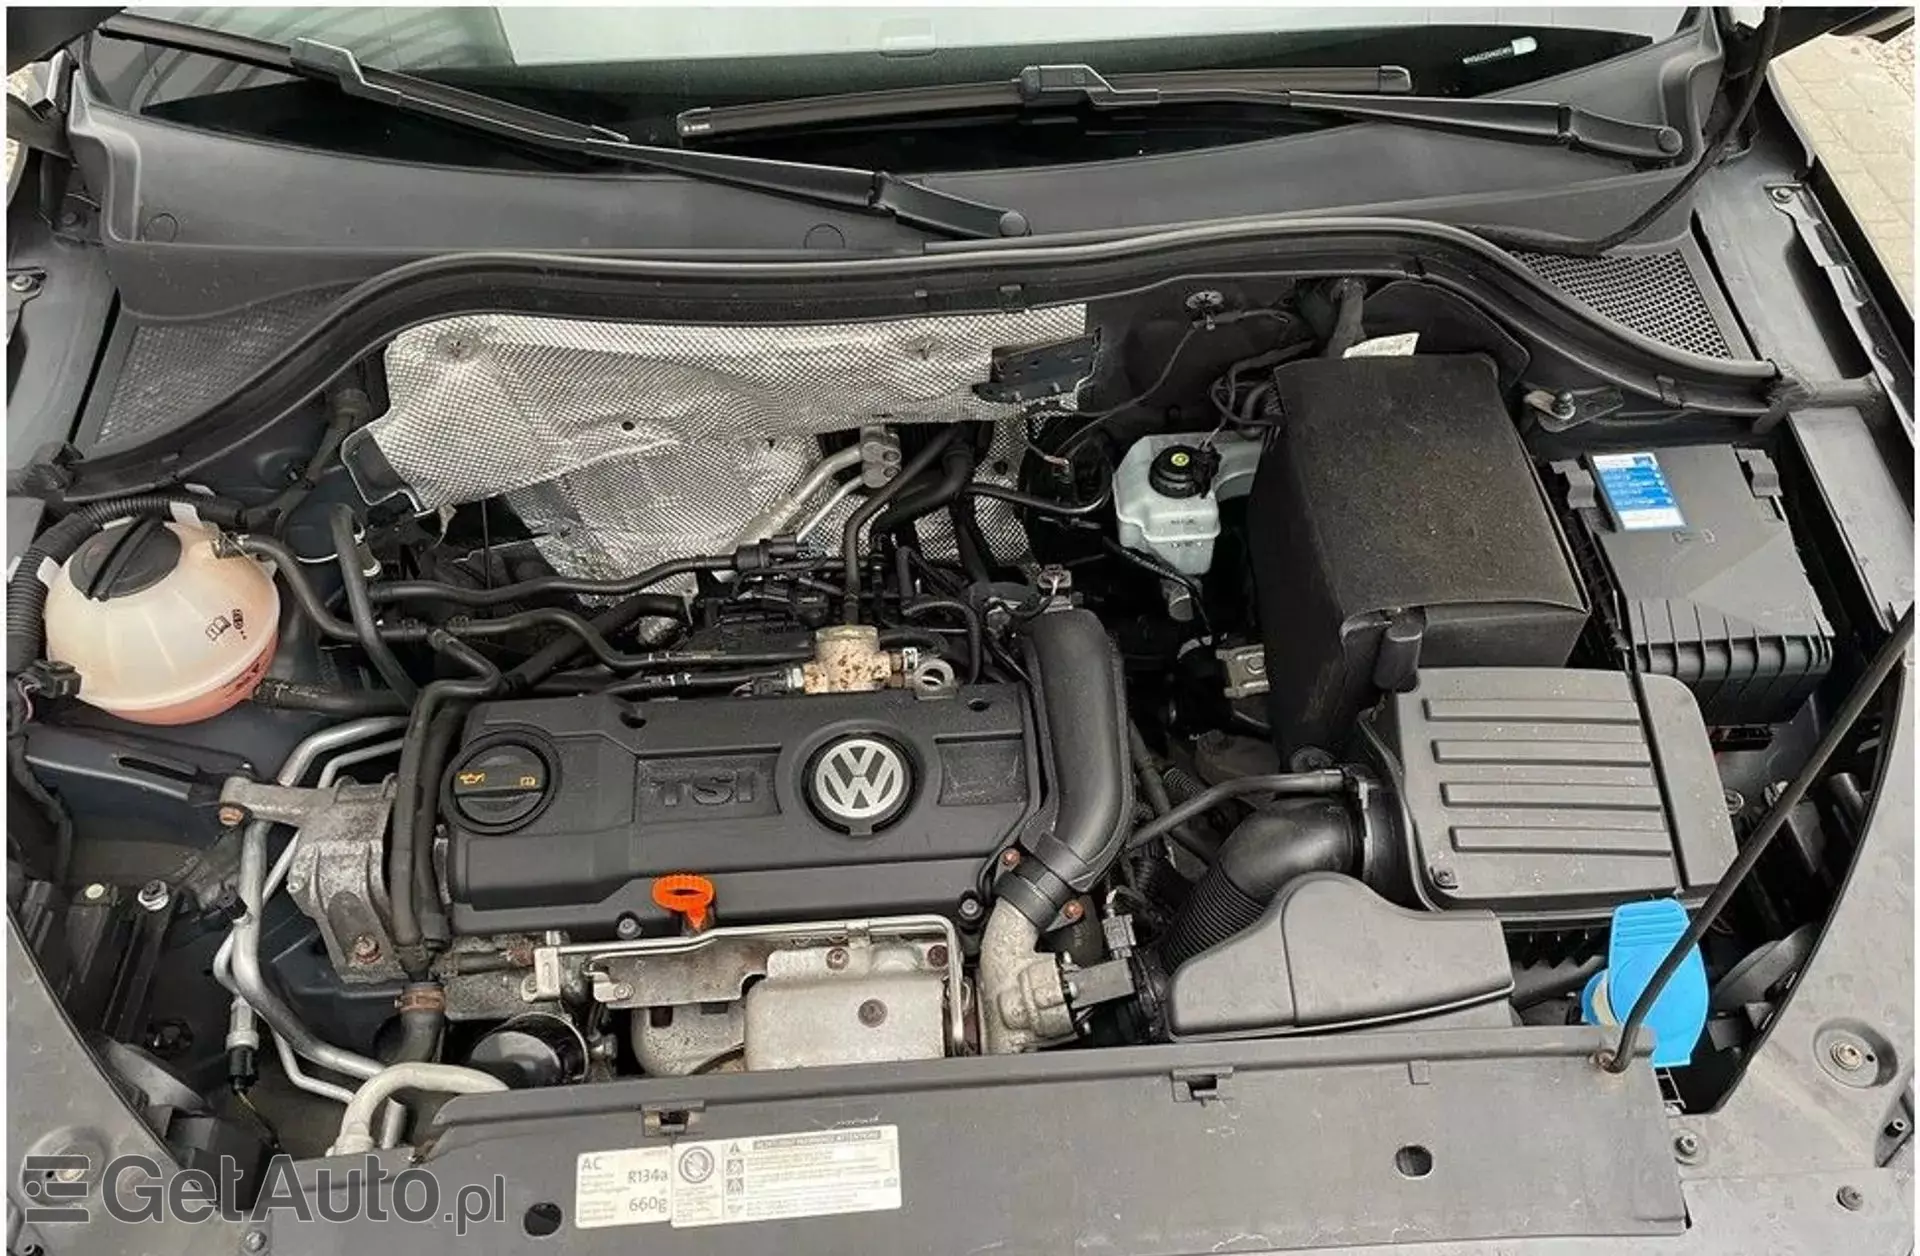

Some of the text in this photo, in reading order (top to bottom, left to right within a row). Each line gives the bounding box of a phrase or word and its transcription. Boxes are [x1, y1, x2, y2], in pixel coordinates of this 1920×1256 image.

[816, 739, 903, 818] VW
[650, 769, 752, 807] TSI
[582, 1157, 602, 1171] AC
[627, 1168, 668, 1184] R134a
[629, 1196, 667, 1213] 660g
